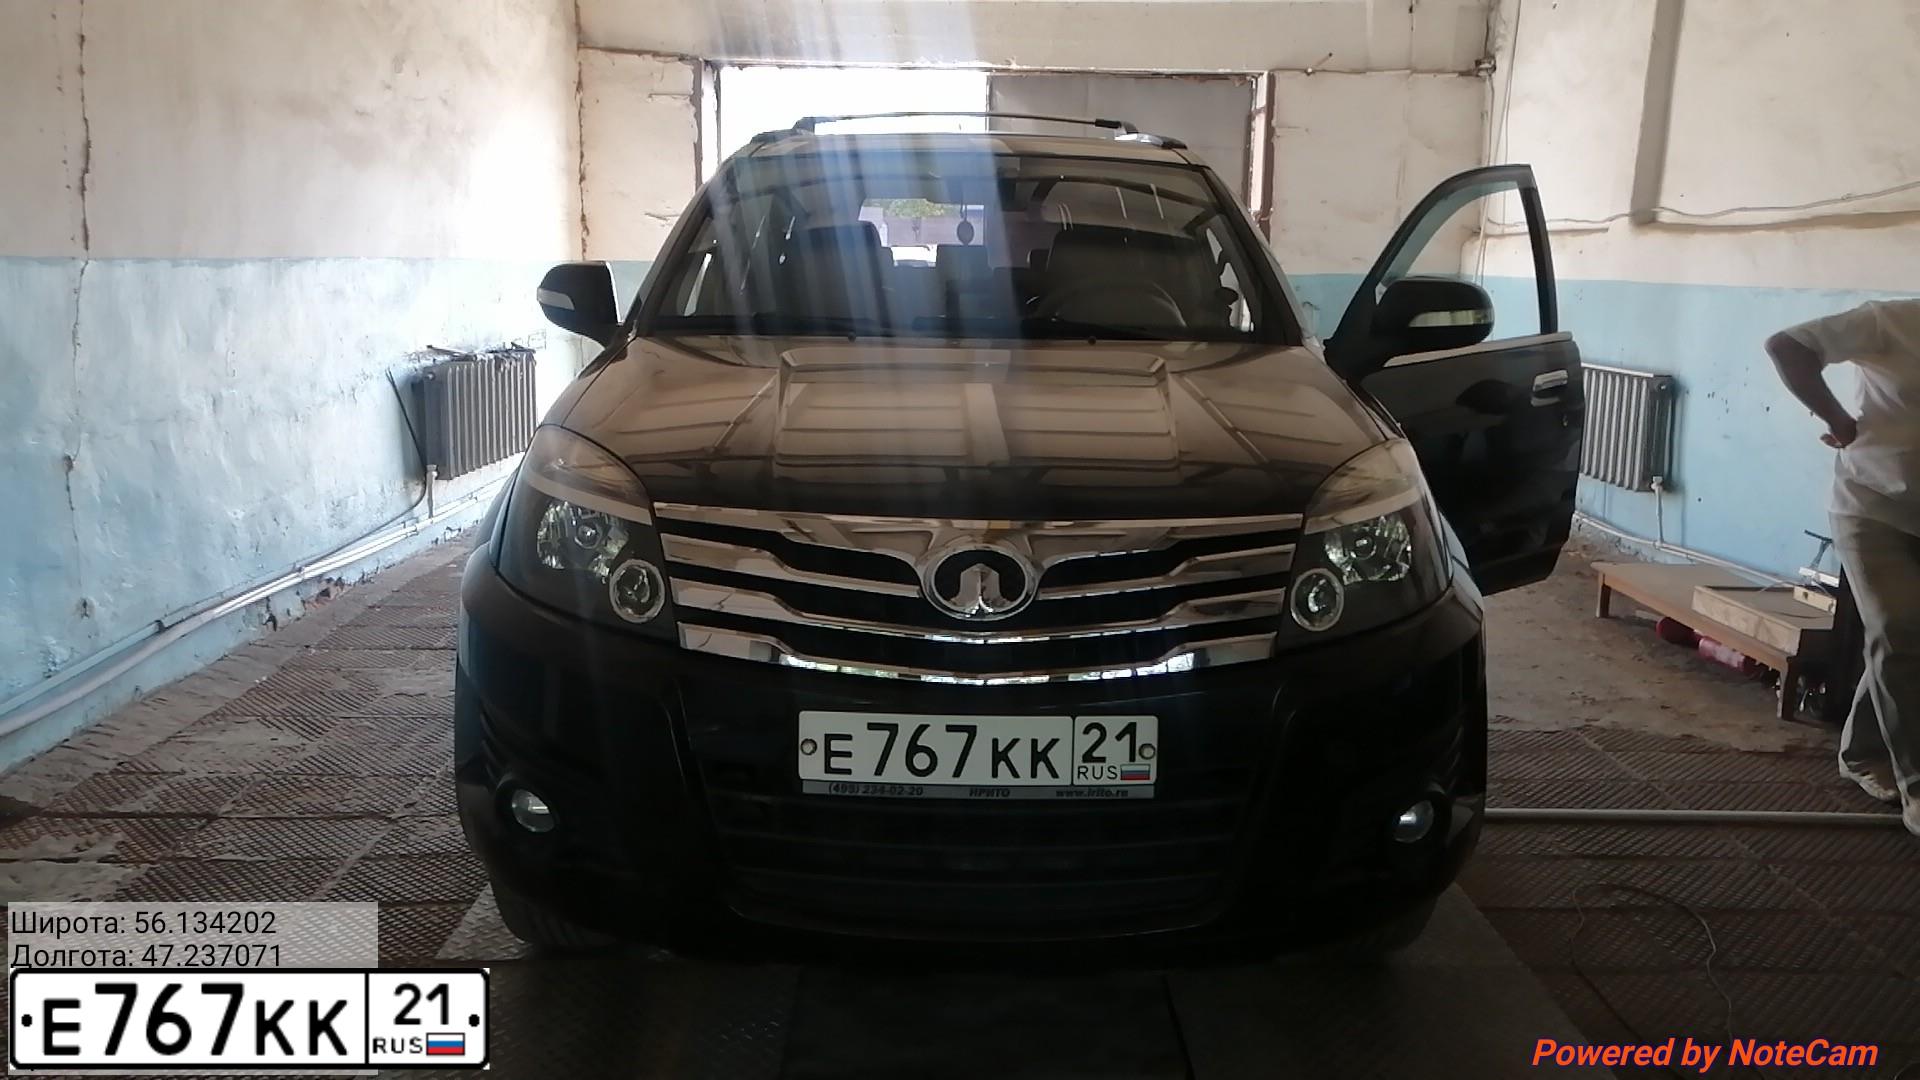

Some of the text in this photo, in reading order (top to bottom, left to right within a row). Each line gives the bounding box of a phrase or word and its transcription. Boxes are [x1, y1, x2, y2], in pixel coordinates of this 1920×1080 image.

[824, 722, 1060, 779] Е767КК
[1081, 721, 1137, 763] 21
[1077, 765, 1118, 780] RUS
